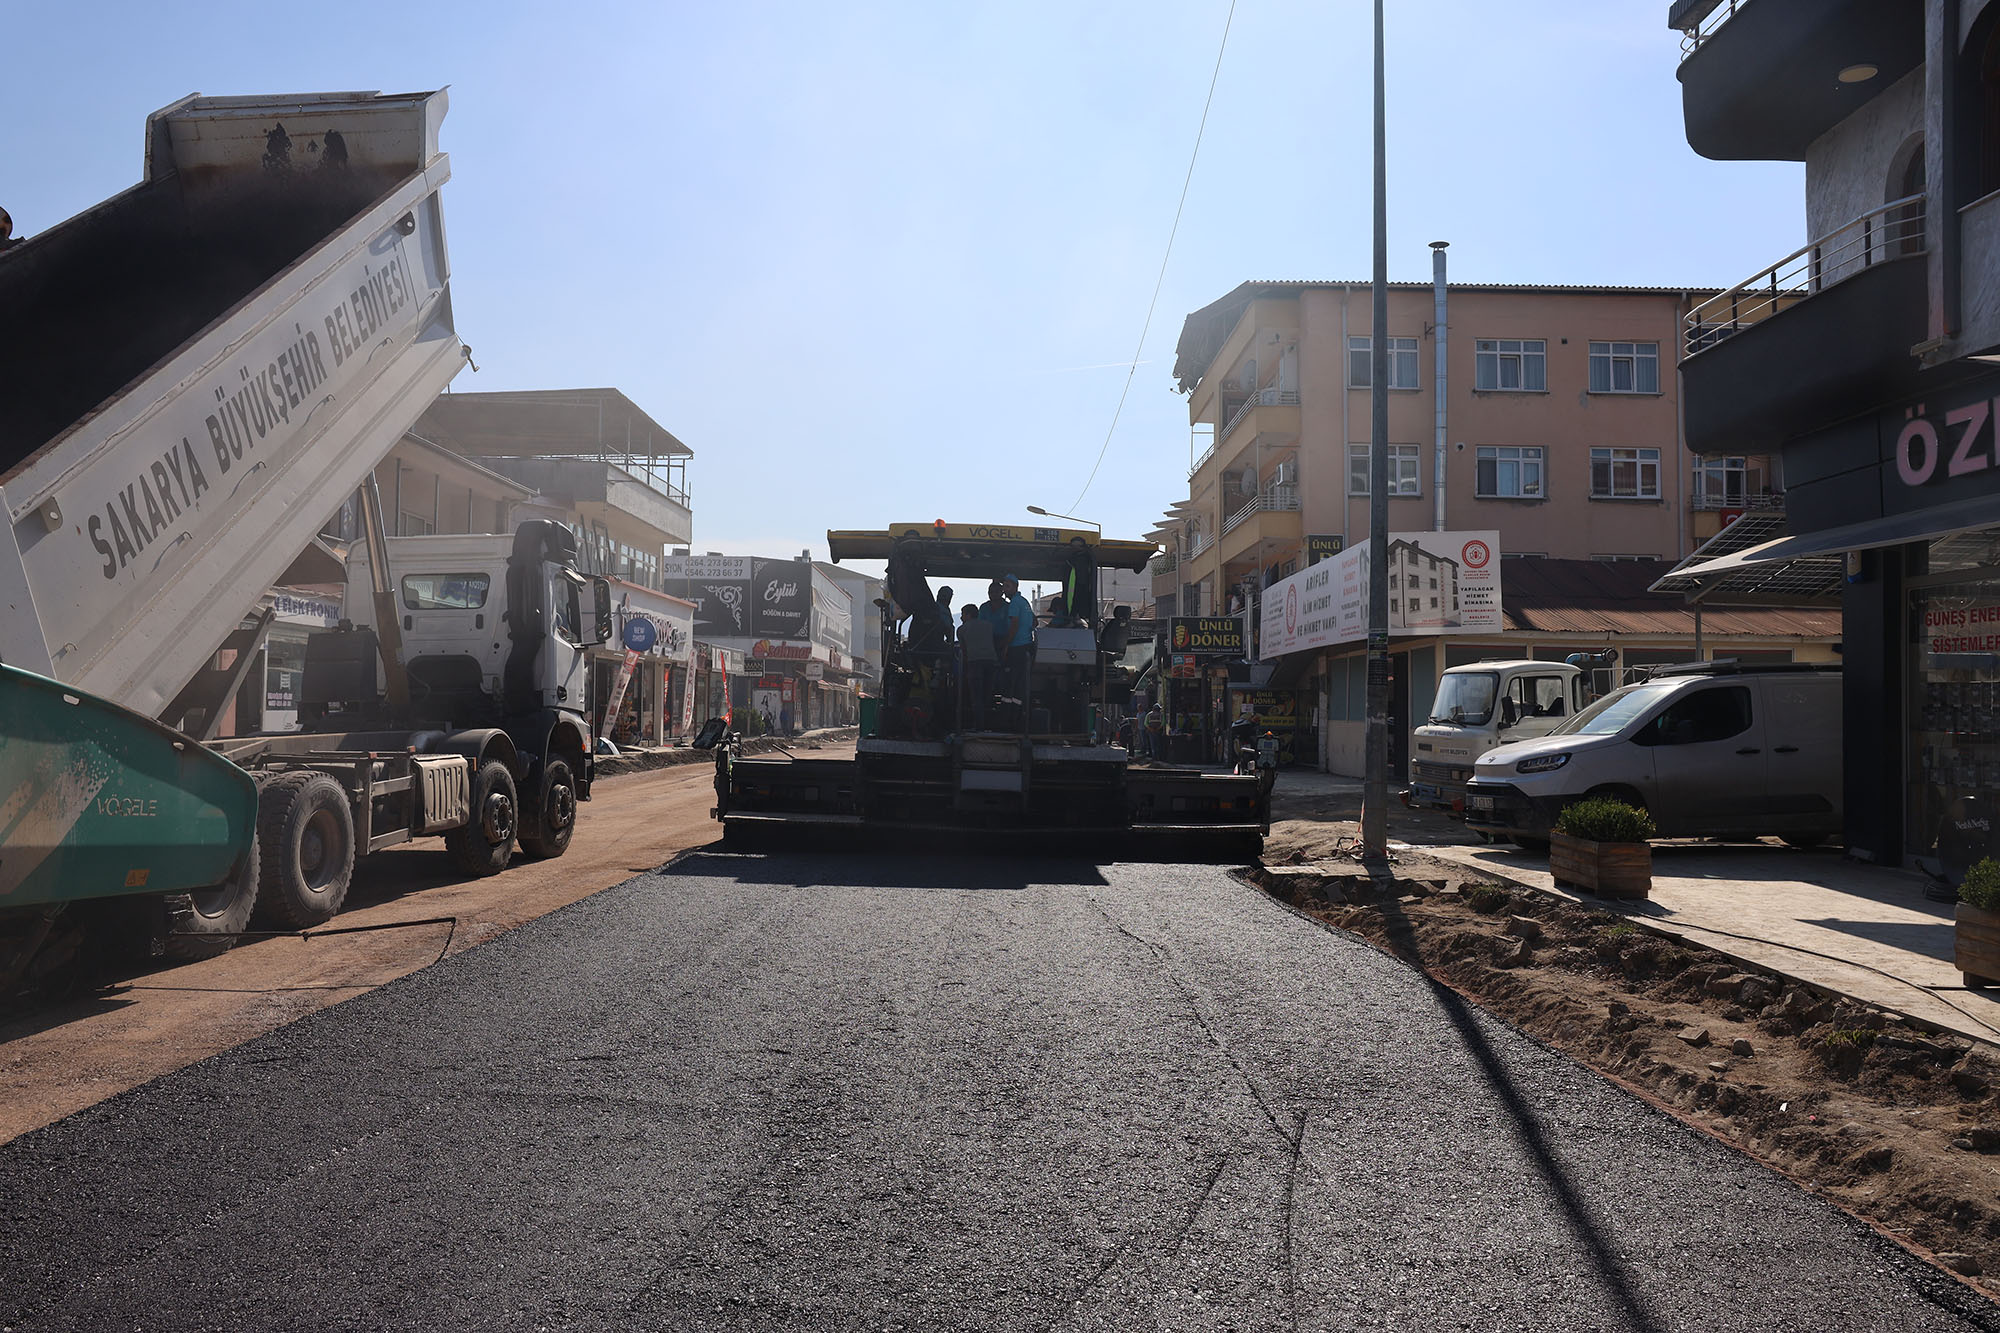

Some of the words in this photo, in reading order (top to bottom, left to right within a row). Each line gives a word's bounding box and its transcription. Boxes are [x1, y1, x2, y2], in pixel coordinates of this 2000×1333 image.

[88, 437, 209, 580] SAKARYA
[205, 323, 328, 475] BÜYÜKŞEHİR
[325, 242, 409, 368] BELEDİYESİ
[1312, 539, 1340, 550] ÜNLÜ
[707, 559, 721, 567] 273
[734, 559, 743, 567] 37
[707, 569, 721, 577] 273
[722, 569, 732, 577] 66
[734, 569, 743, 577] 37
[764, 580, 797, 604] Eylül
[1199, 619, 1233, 631] ÜNLÜ
[1191, 632, 1241, 646] DÖNER
[97, 794, 158, 816] VÖGELE
